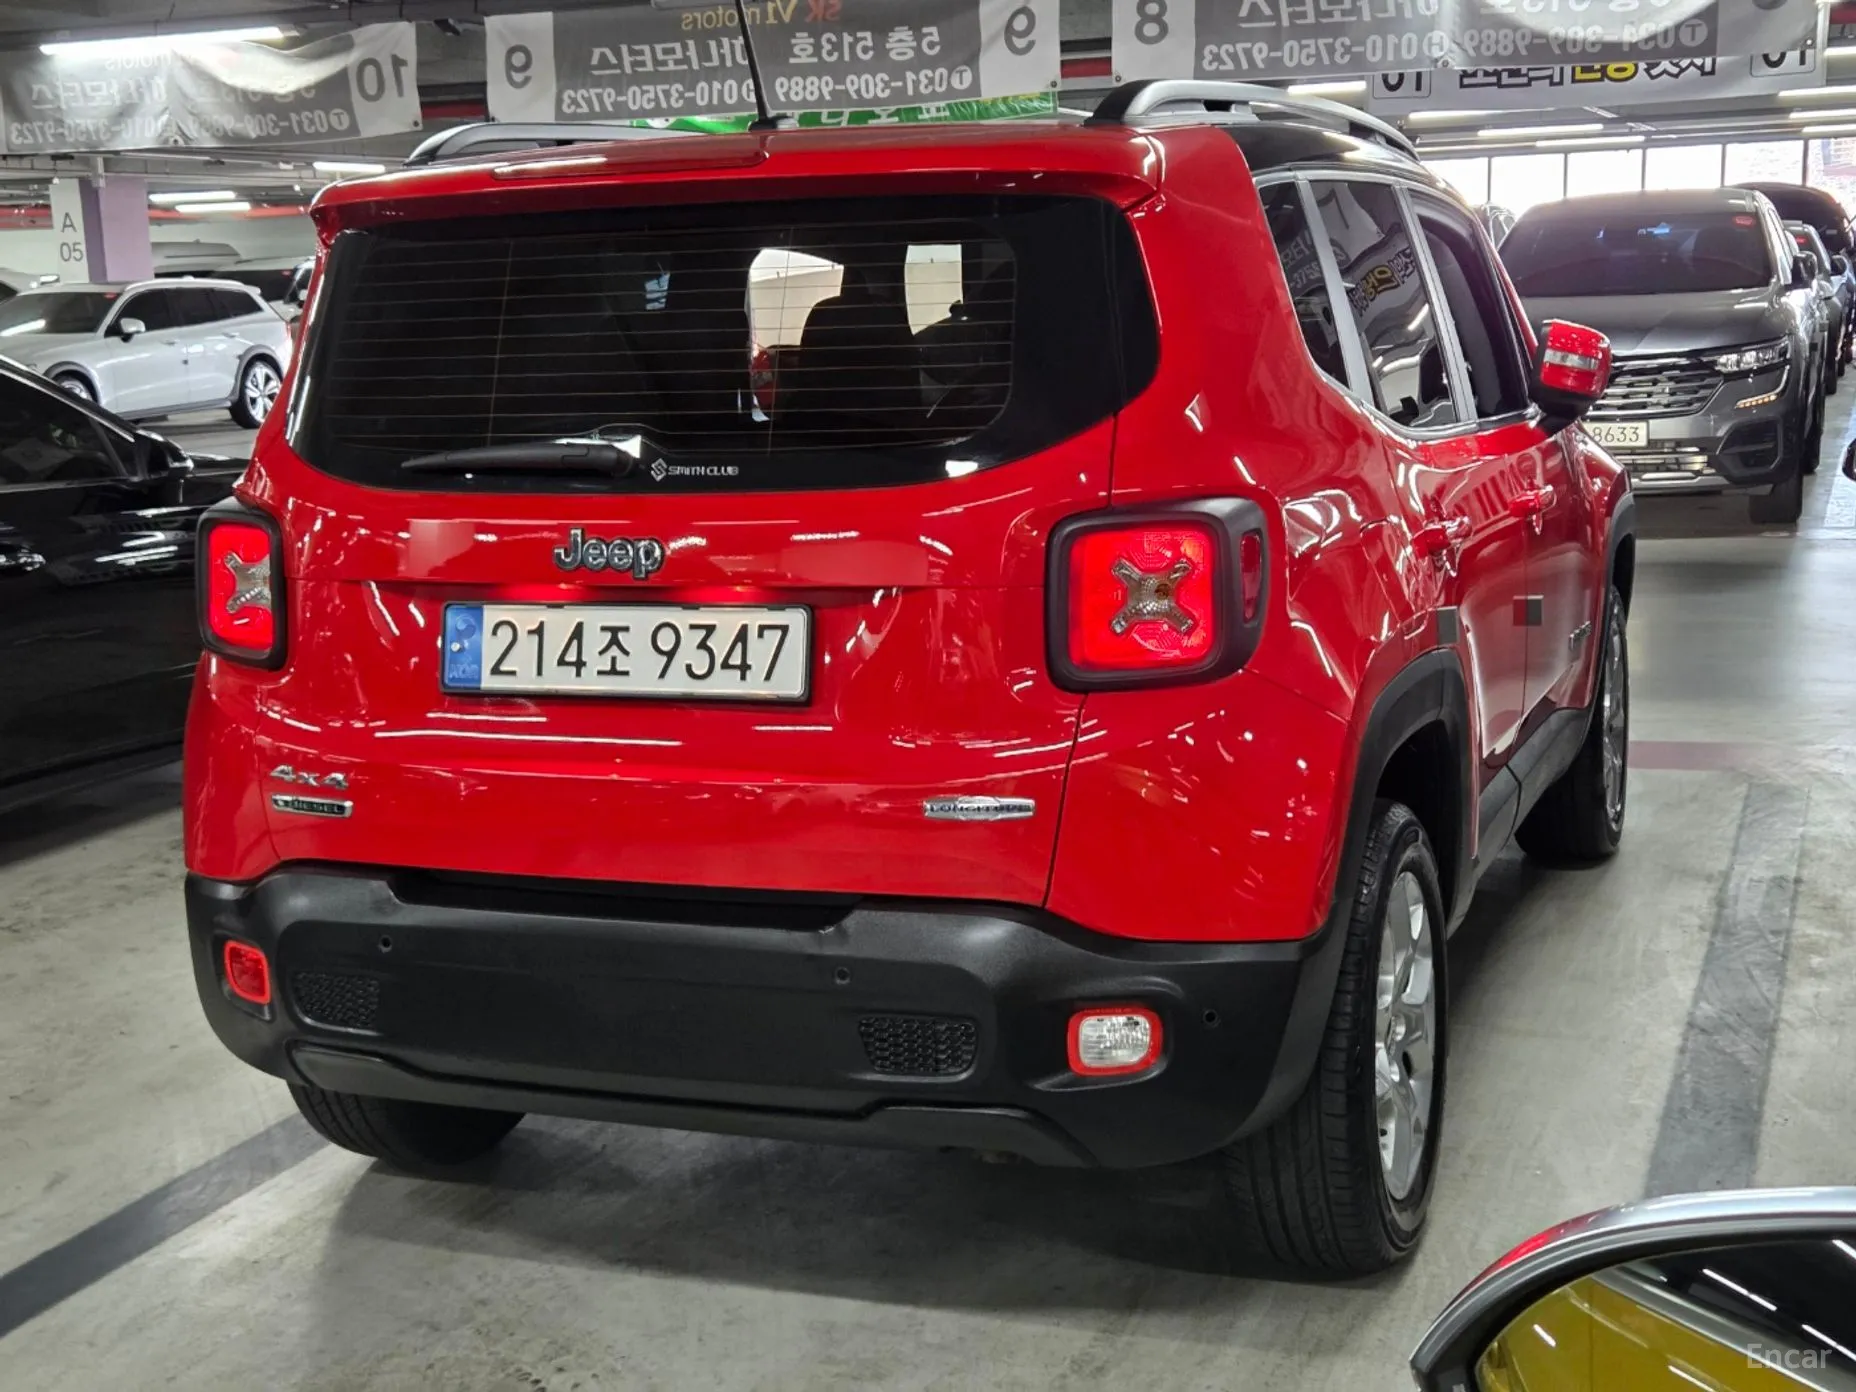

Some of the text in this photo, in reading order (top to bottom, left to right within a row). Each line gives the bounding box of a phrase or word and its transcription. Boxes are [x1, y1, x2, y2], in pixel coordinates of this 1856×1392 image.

[60, 211, 77, 234] A
[59, 243, 84, 263] 05
[1592, 426, 1640, 443] 8633
[553, 527, 666, 580] Jeep
[489, 619, 790, 682] 214조 9347
